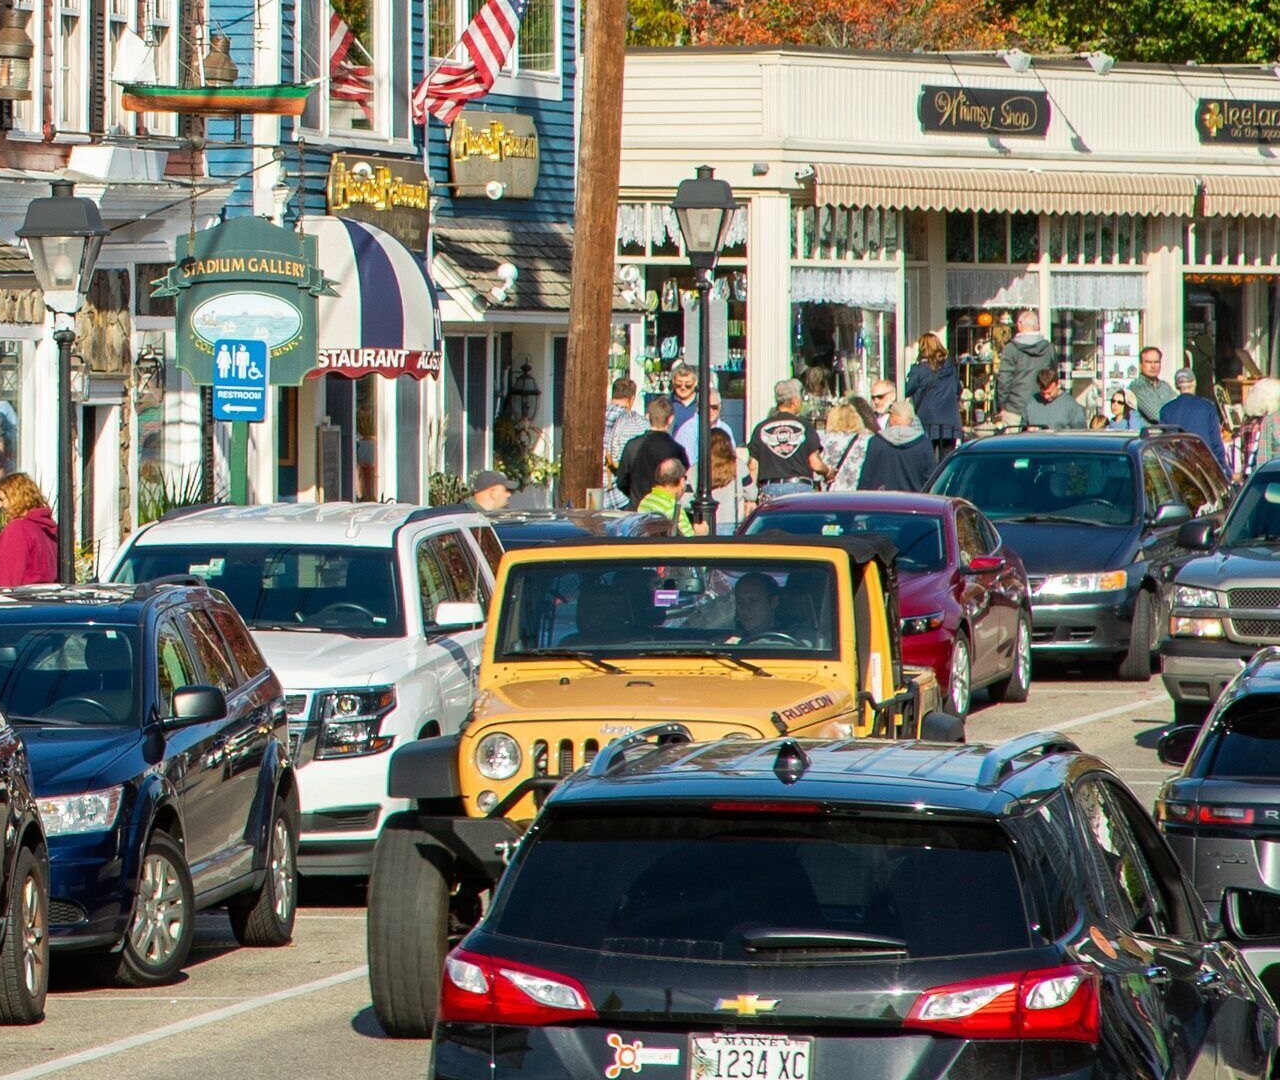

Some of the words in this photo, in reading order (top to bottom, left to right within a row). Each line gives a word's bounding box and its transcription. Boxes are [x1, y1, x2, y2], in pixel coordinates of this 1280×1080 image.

[939, 89, 995, 129] Whimsy
[1001, 100, 1033, 130] Shop
[183, 258, 245, 278] STADIUM
[248, 258, 306, 278] GALLERY
[217, 390, 262, 400] RESTROOM
[781, 694, 834, 721] RUBICON
[724, 1037, 778, 1047] MAINE
[714, 1049, 768, 1079] 1234
[779, 1050, 806, 1079] XC
